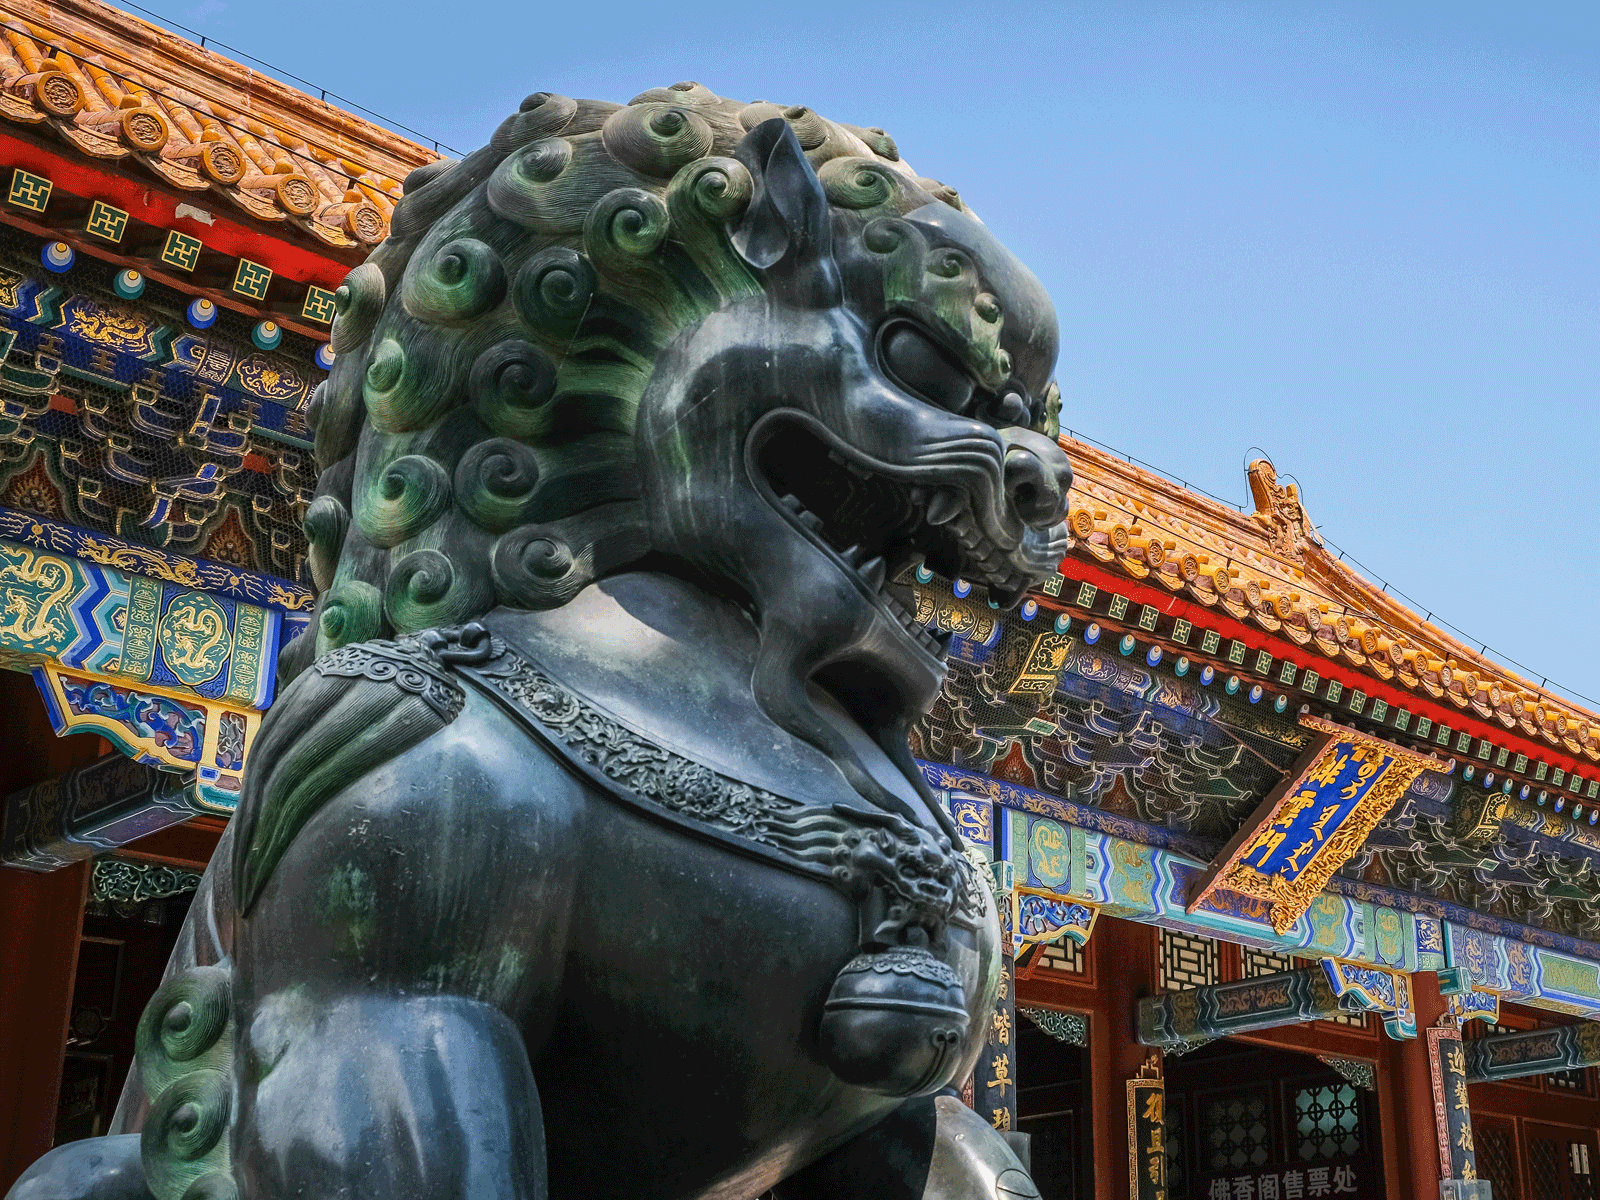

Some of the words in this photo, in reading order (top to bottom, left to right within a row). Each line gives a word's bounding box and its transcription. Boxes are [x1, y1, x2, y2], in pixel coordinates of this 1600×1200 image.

[1243, 749, 1348, 867] 排雲門
[1143, 1093, 1165, 1200] 復旦引
[1208, 1165, 1358, 1200] 佛香阁售票处
